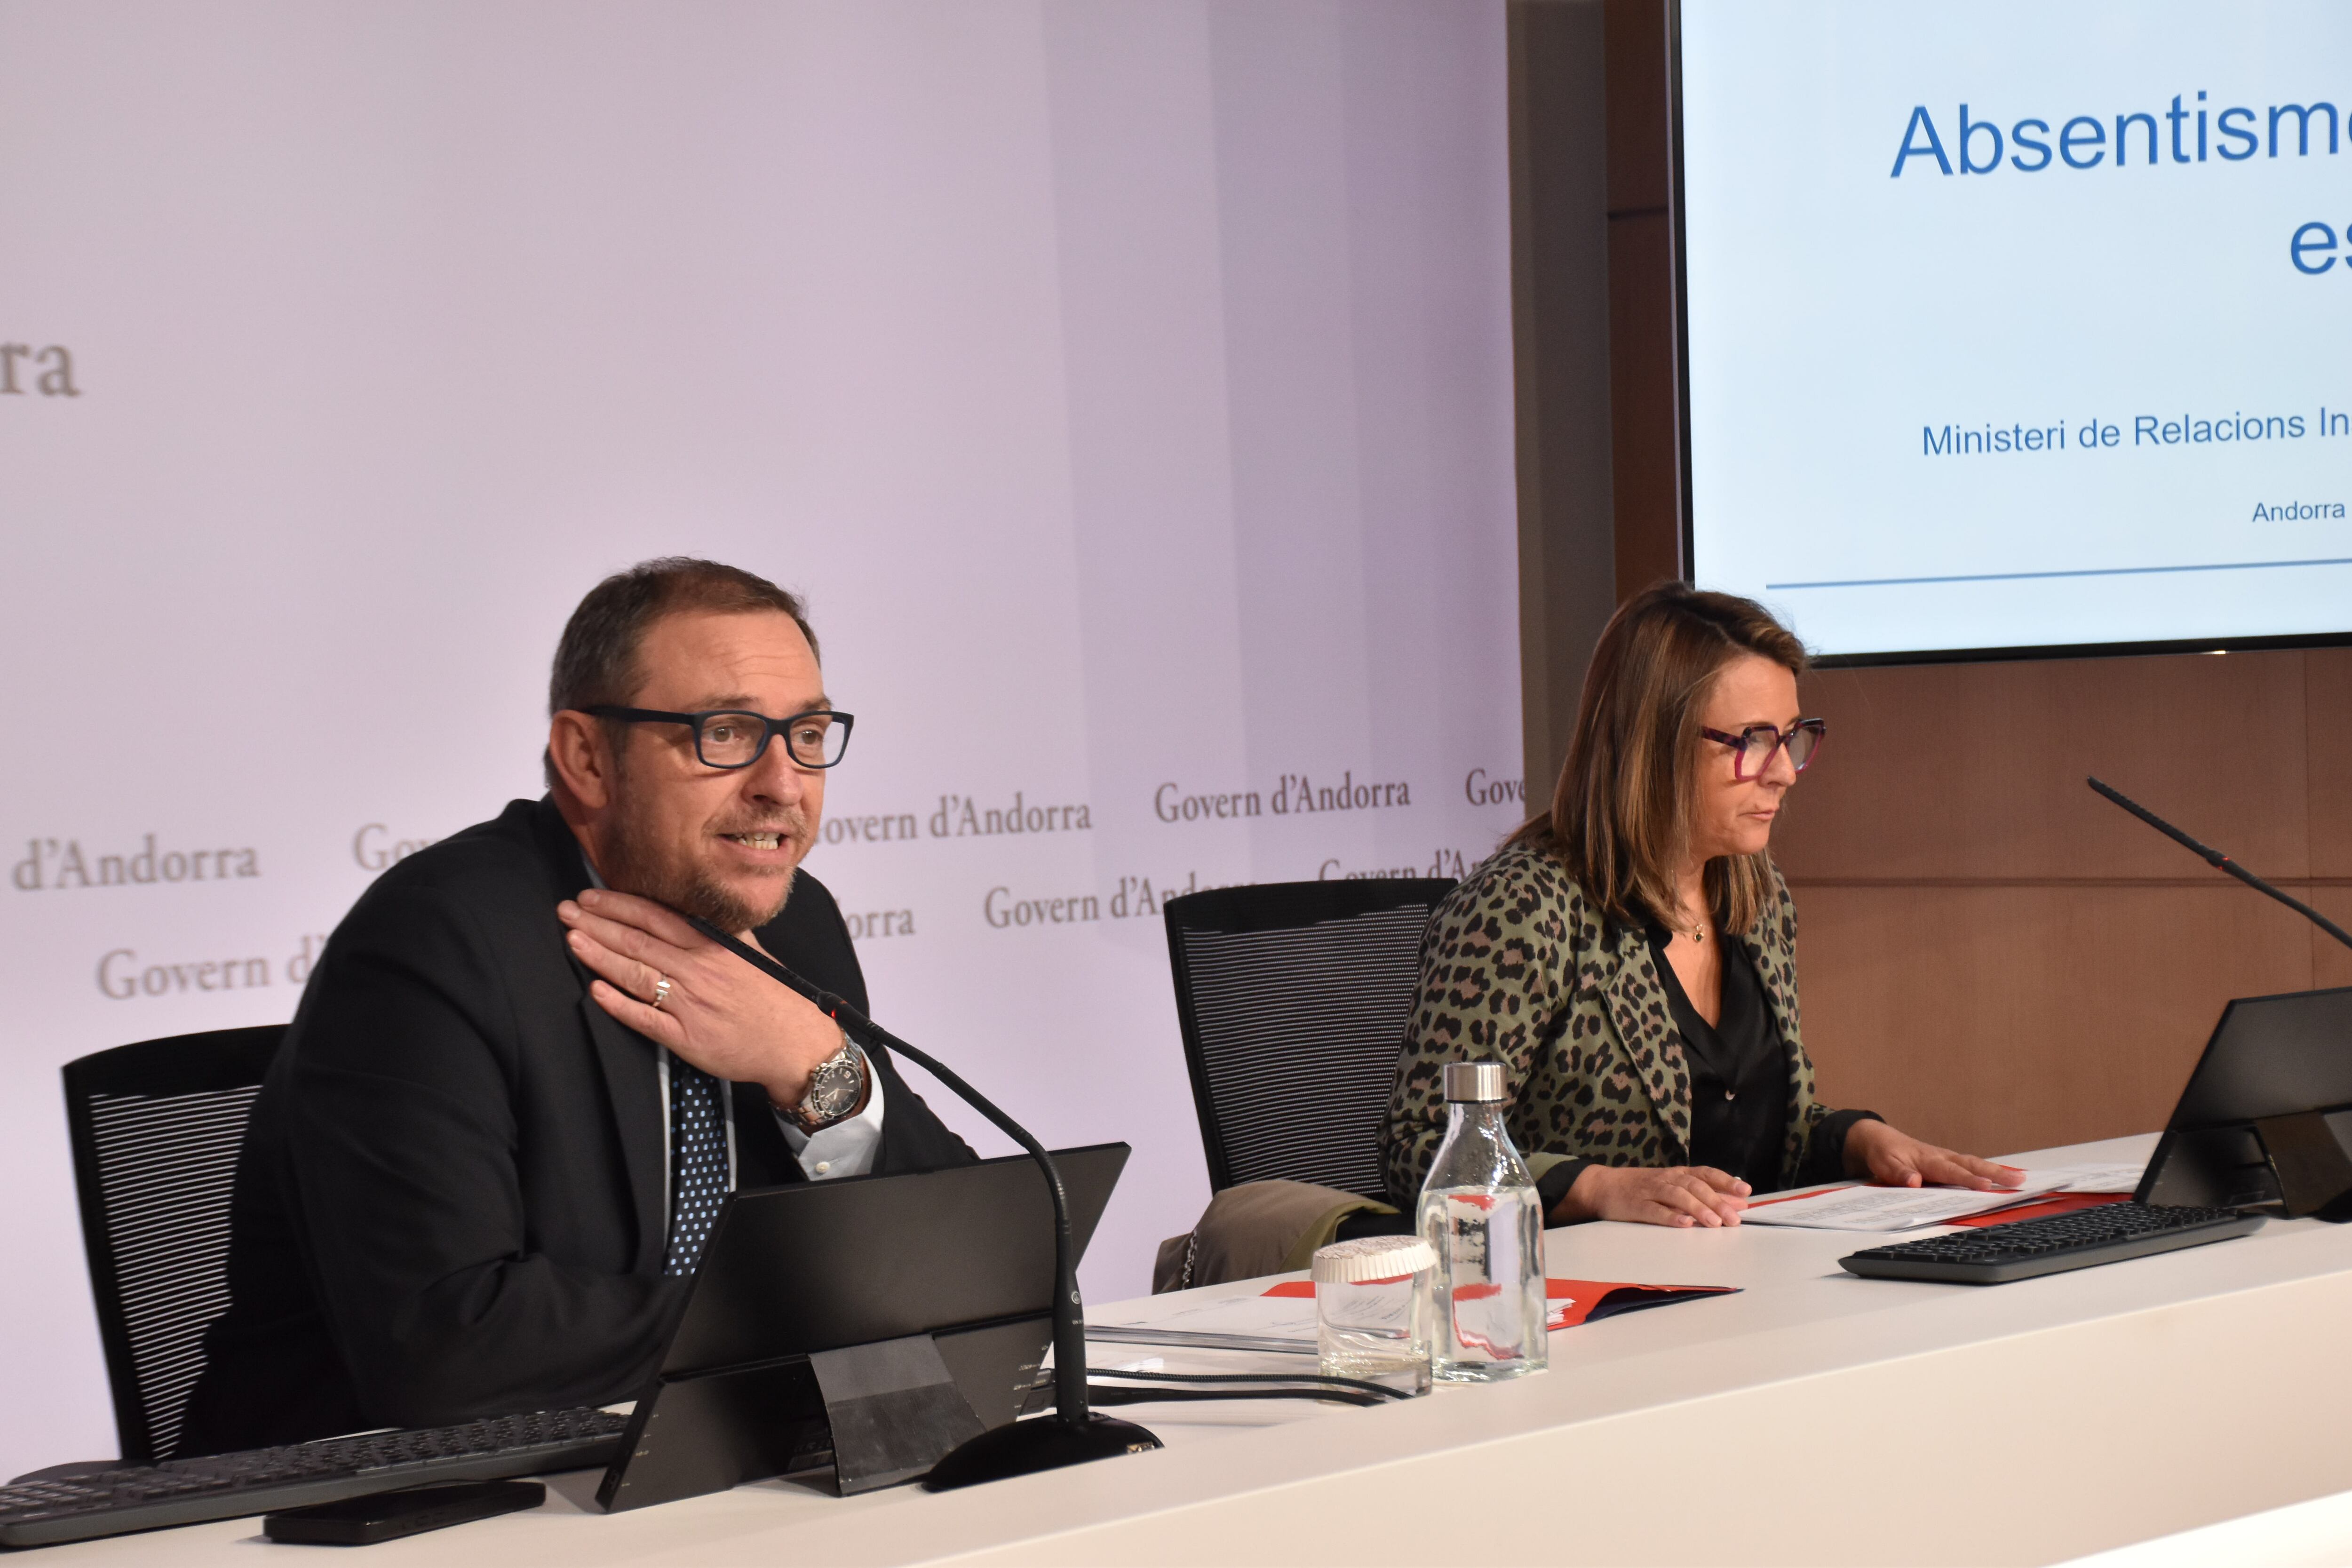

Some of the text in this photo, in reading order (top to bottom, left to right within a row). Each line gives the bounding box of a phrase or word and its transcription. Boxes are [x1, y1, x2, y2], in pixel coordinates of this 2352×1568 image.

[1890, 90, 2352, 178] Absentism
[2290, 221, 2352, 276] e
[1923, 420, 2066, 456] Ministeri
[2078, 418, 2121, 449] de
[2135, 411, 2306, 446] Relacions
[2252, 500, 2346, 523] Andorra
[813, 791, 1094, 845] overn d’Andorra
[1154, 770, 1412, 823] Govern d’Andorra
[10, 832, 261, 893] d’Andorra
[836, 899, 916, 942] orra
[983, 886, 1101, 929] Govern
[95, 947, 271, 1001] Govern
